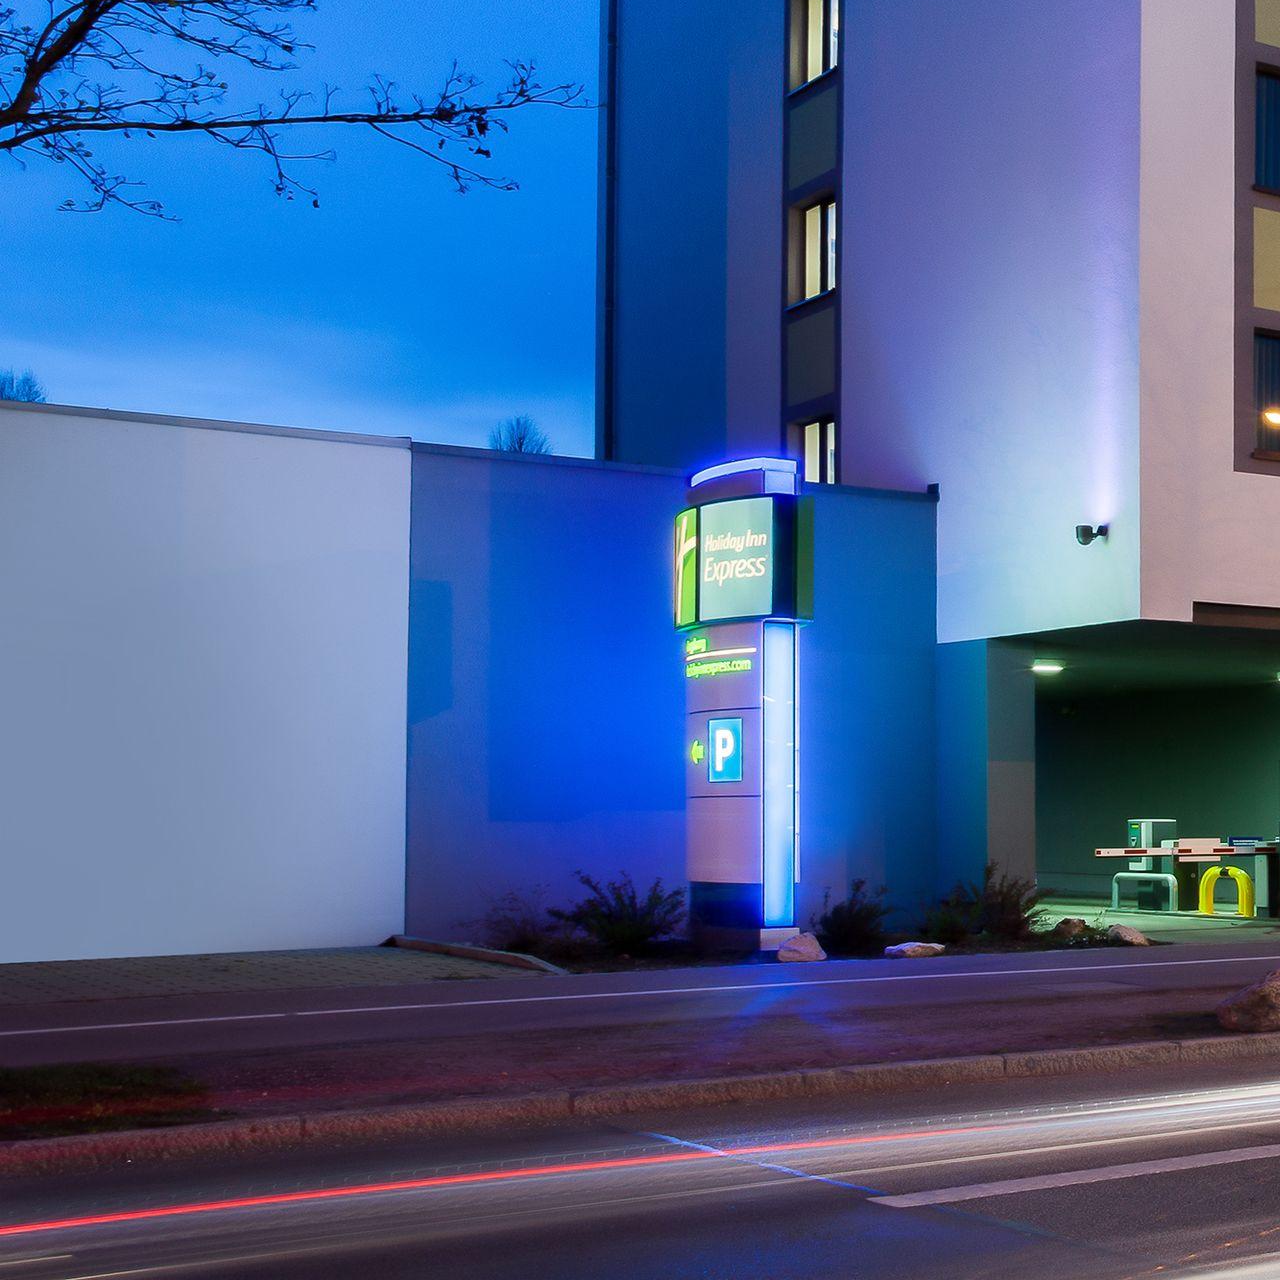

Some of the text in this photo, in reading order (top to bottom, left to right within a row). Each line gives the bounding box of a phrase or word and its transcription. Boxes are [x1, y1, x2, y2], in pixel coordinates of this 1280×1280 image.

[704, 528, 767, 552] Holiday Inn
[703, 556, 767, 587] Express
[715, 728, 735, 772] P
